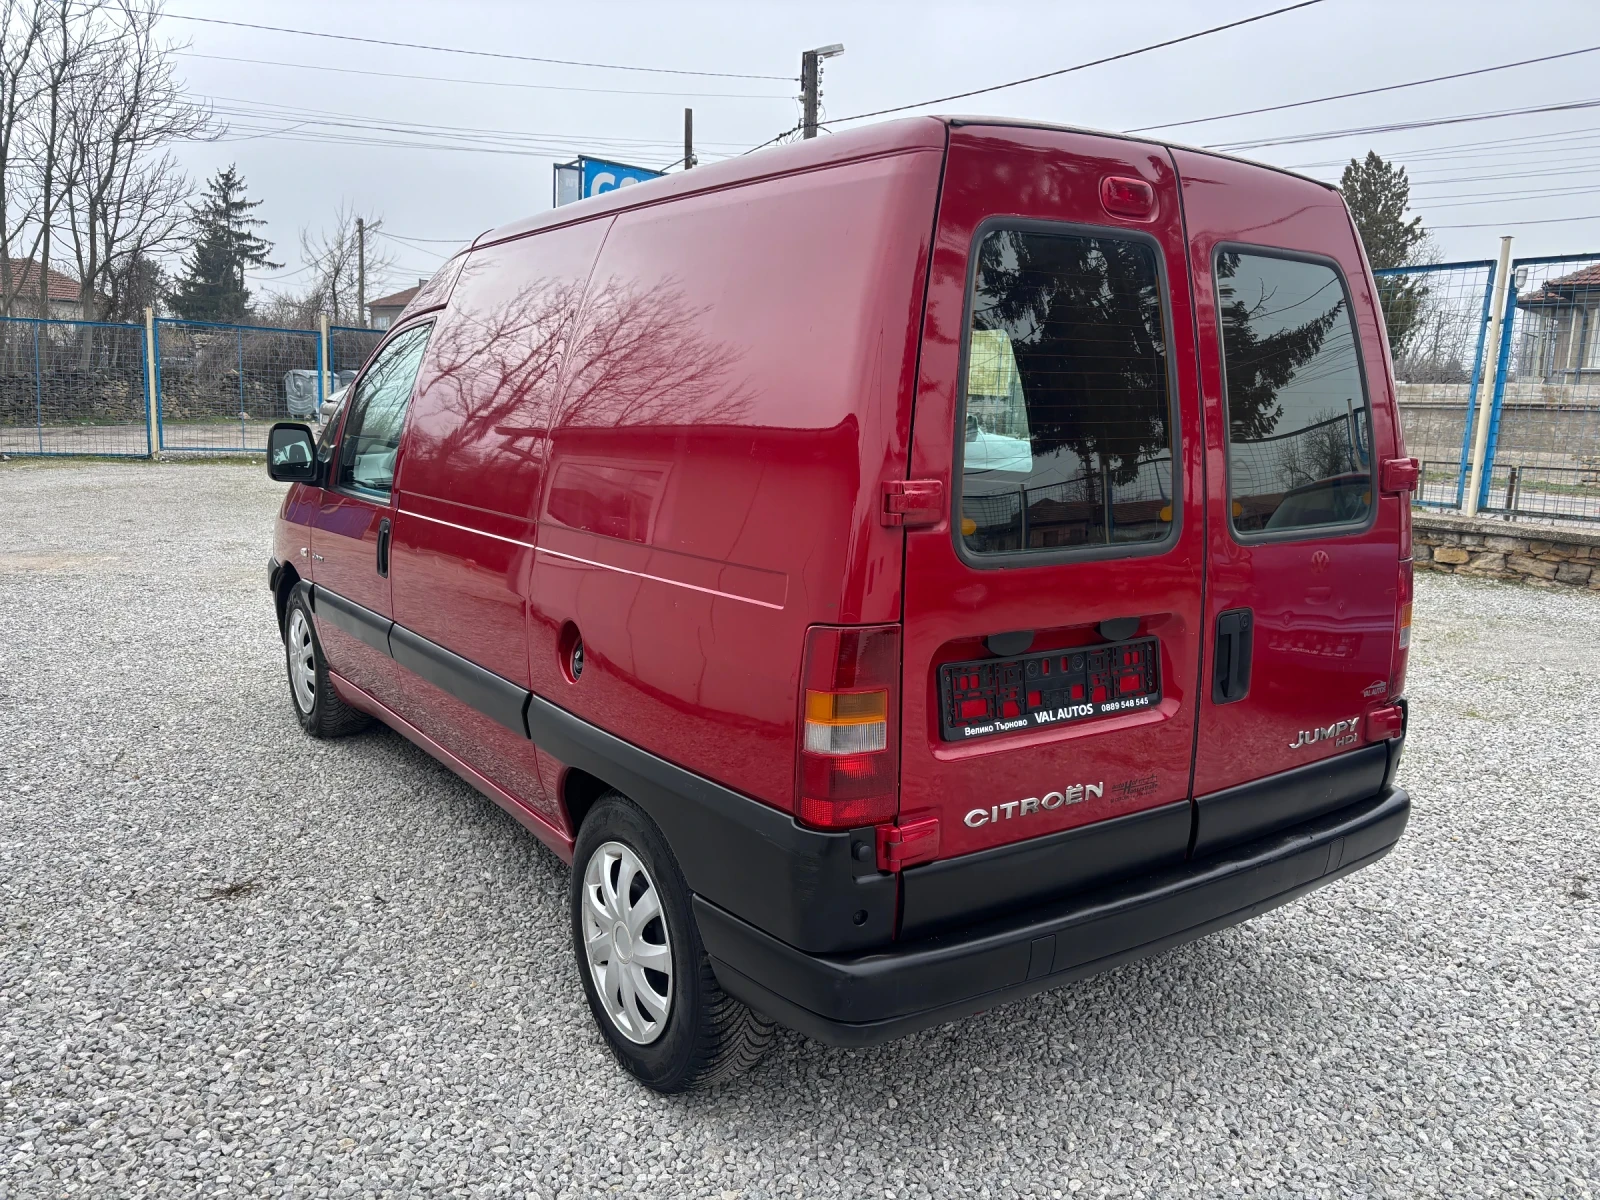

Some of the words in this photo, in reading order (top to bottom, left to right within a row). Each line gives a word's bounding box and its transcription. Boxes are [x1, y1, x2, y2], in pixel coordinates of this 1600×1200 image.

[1034, 710, 1056, 723] VAL
[1057, 703, 1094, 720] AUTOS
[1101, 701, 1120, 712] 0889
[1120, 699, 1135, 709] 548
[1135, 696, 1149, 706] 545
[964, 725, 994, 736] Велико
[994, 719, 1028, 731] Търново
[1288, 716, 1360, 749] JUMPY
[963, 781, 1104, 828] CITROËN
